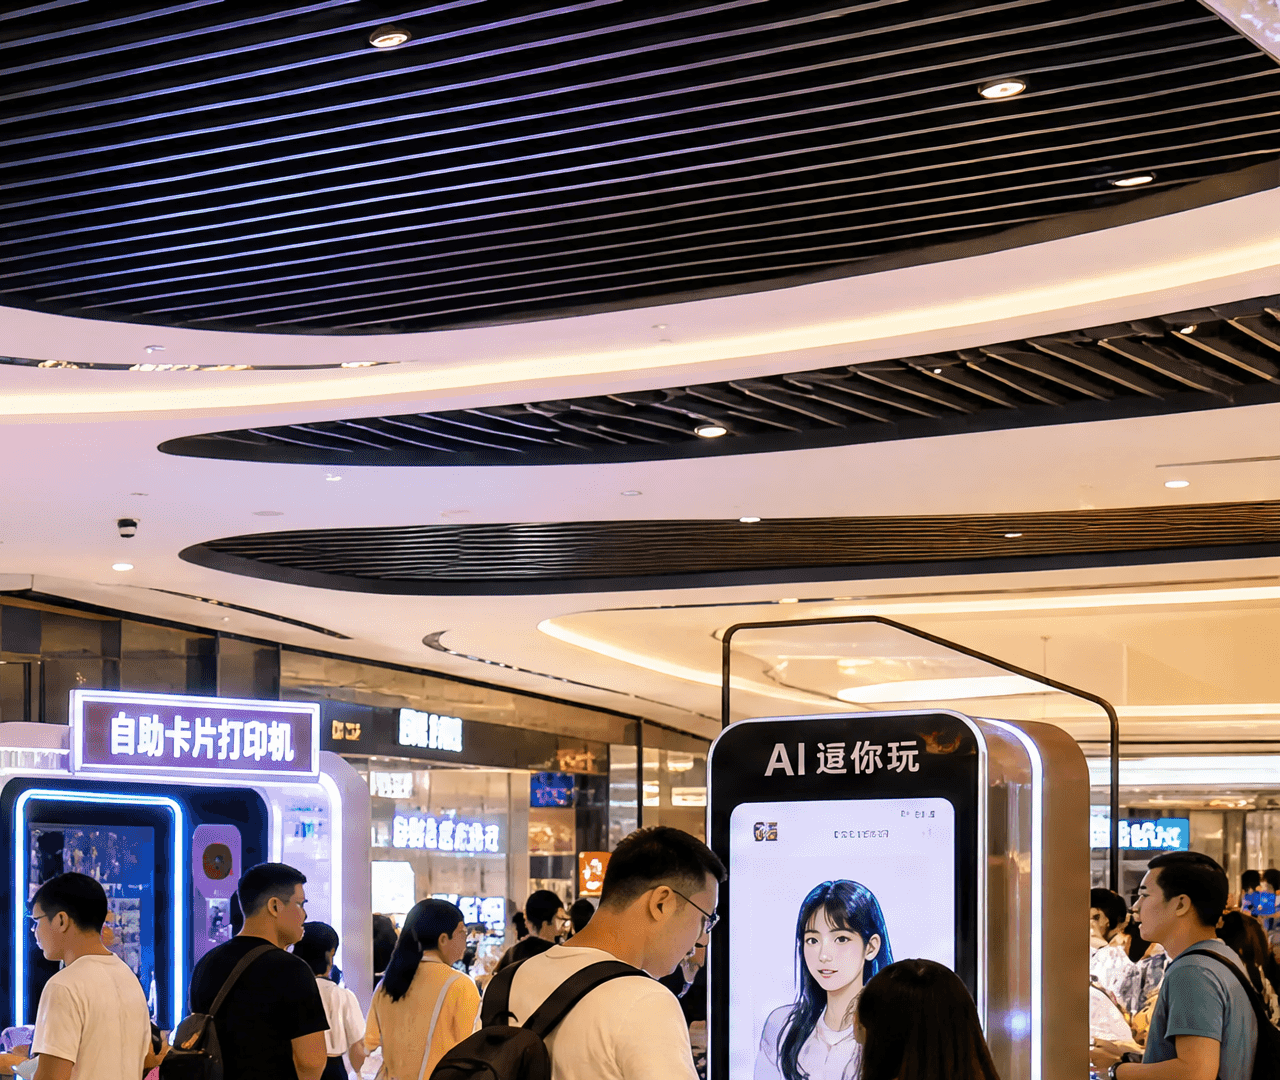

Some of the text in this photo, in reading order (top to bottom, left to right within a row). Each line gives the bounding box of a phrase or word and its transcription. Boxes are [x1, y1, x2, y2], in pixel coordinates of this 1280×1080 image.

[111, 711, 295, 762] 自助卡片打印机
[764, 742, 806, 777] AI
